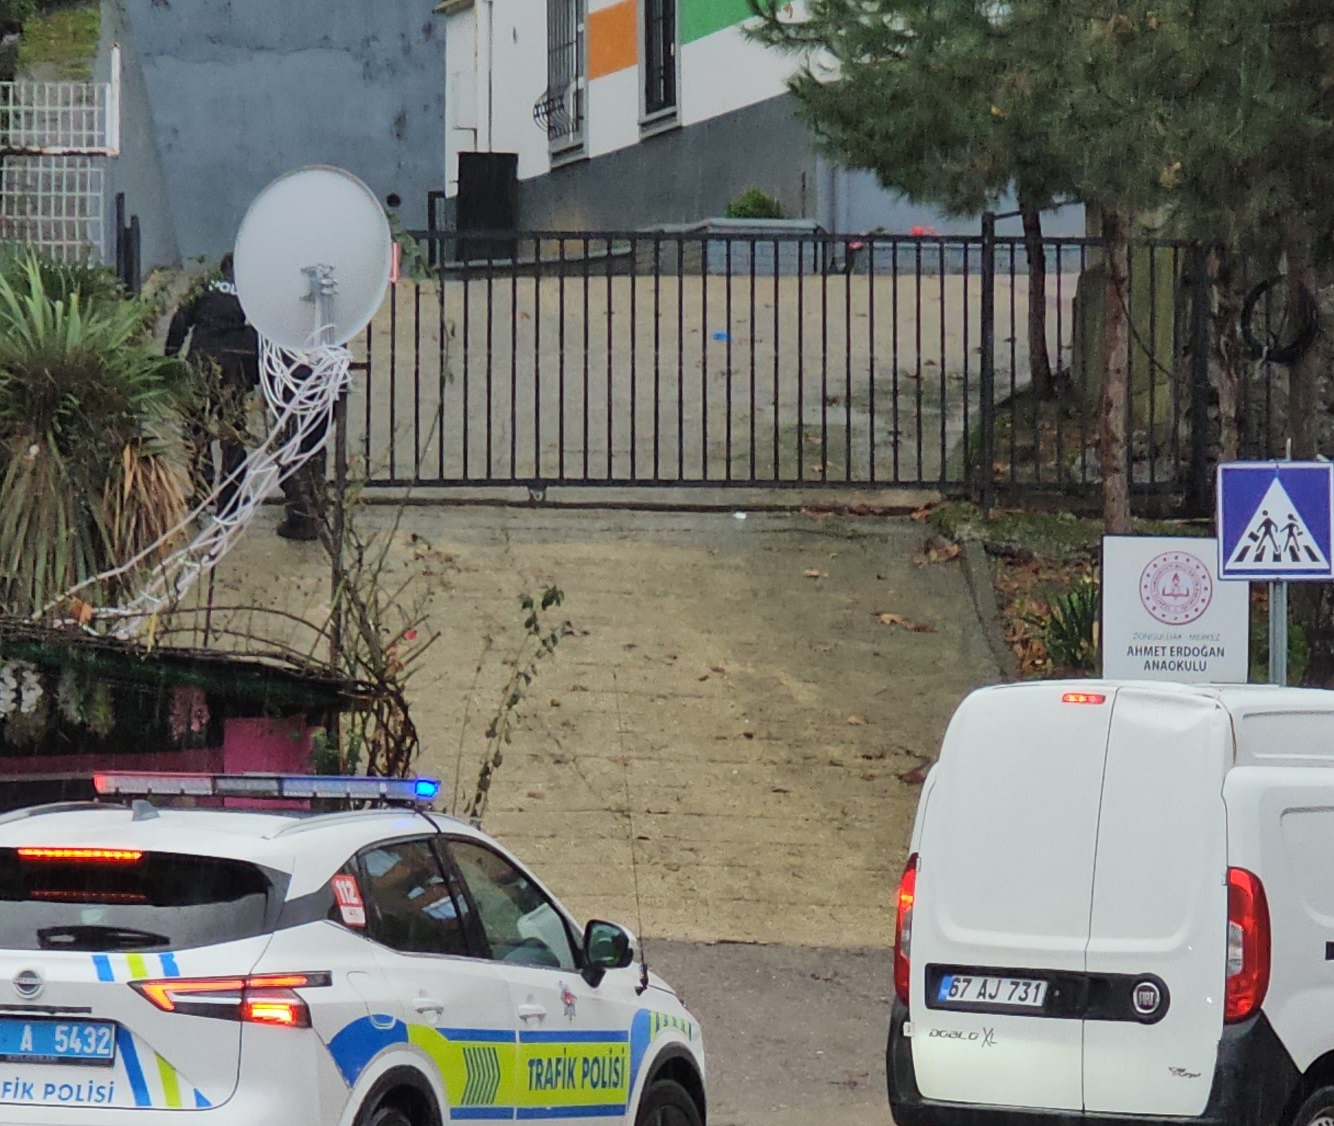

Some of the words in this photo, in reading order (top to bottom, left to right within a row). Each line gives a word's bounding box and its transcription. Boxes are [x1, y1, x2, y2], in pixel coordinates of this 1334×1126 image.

[1127, 645, 1166, 657] AHMET
[1169, 644, 1225, 657] ERDOĞAN
[1143, 659, 1207, 672] ANAOKULU
[948, 977, 972, 999] 67
[976, 979, 1002, 1001] AJ
[1007, 981, 1041, 1004] 731
[20, 1024, 33, 1051] A
[54, 1025, 111, 1054] 5432
[528, 1047, 576, 1091] TRAFİK
[581, 1046, 625, 1090] POLİSİ
[43, 1079, 115, 1103] POLİSİ
